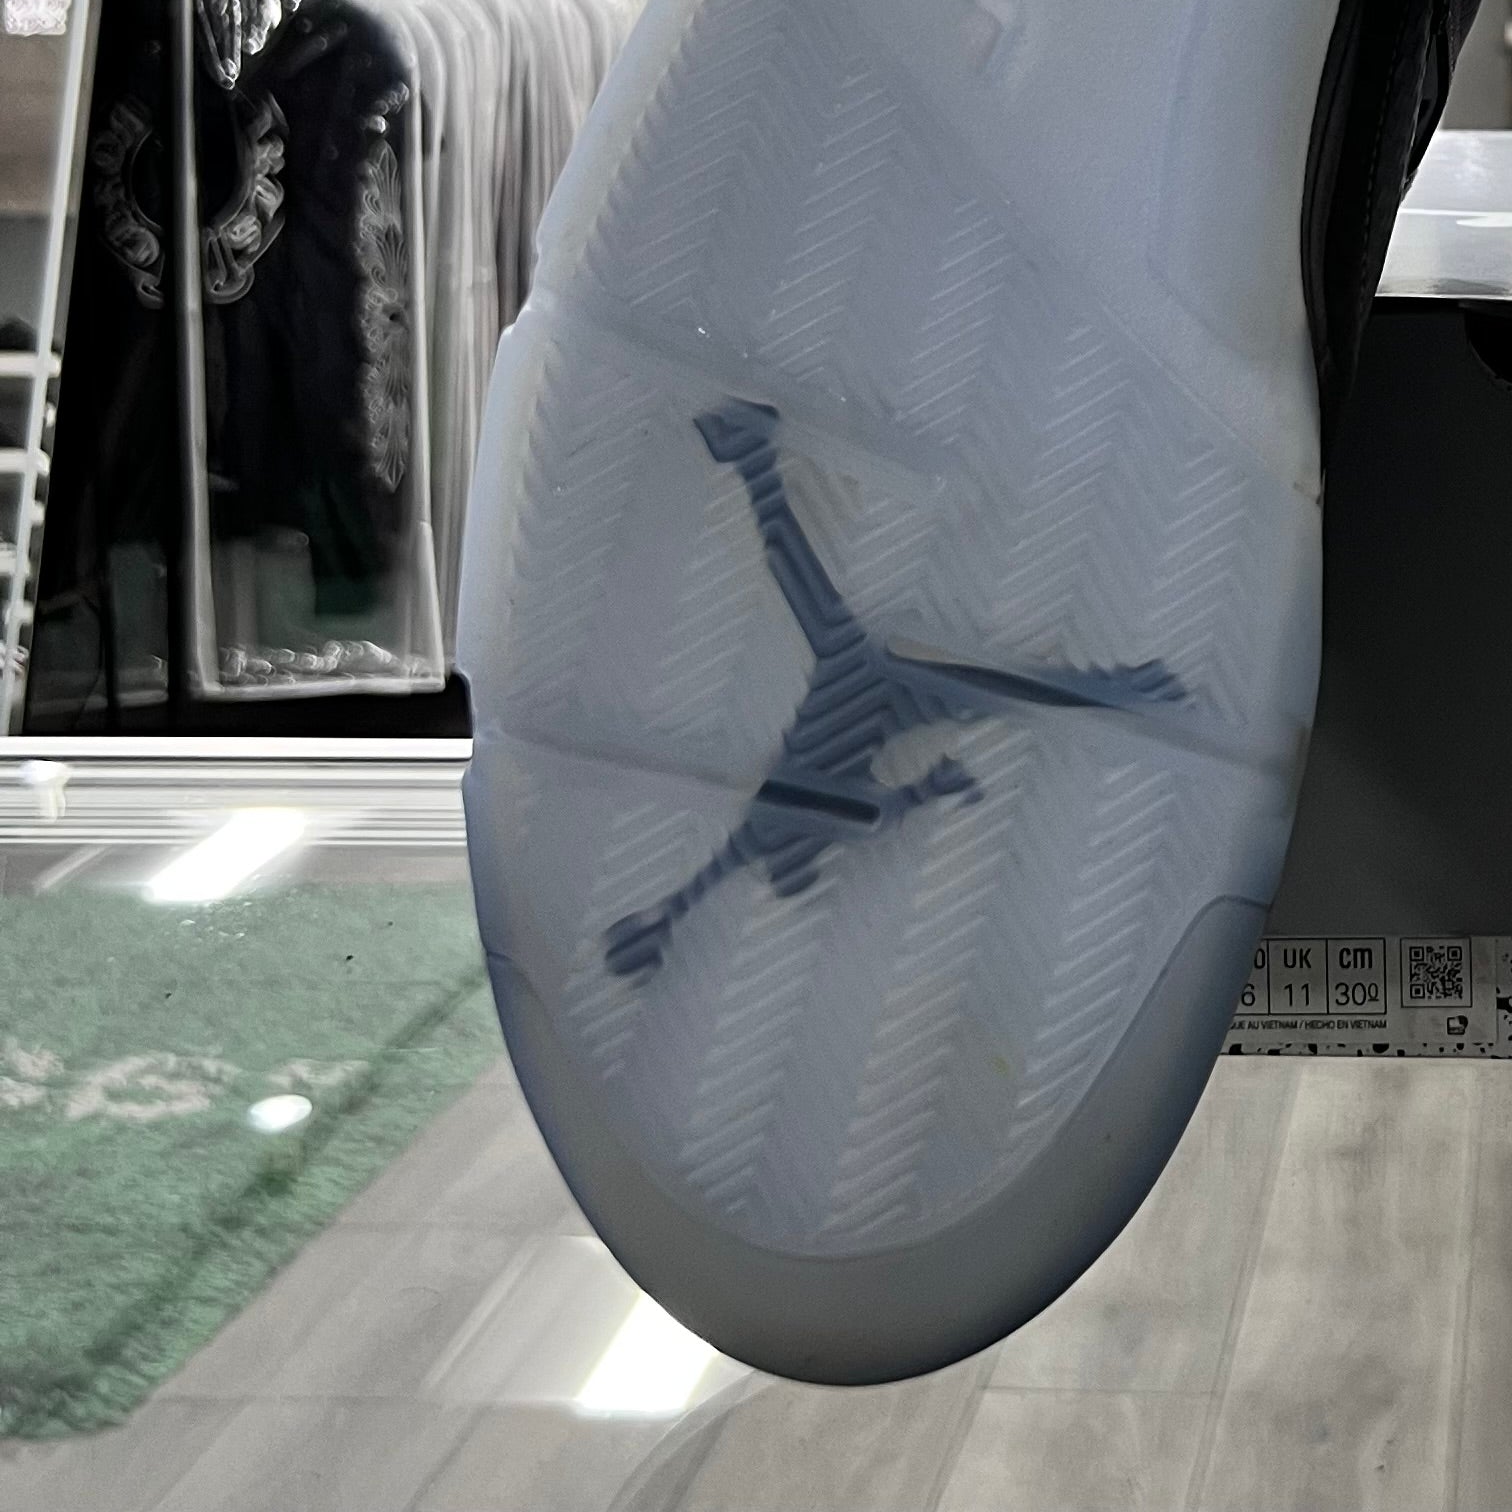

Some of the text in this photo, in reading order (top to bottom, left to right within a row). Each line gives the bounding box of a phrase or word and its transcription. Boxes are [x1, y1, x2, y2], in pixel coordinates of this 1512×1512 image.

[1283, 948, 1312, 969] UK
[1283, 983, 1310, 1006] 11
[1261, 1019, 1297, 1029] VIETNAM
[1305, 1019, 1336, 1029] HECHO
[1337, 1019, 1349, 1029] EN
[1350, 1019, 1387, 1029] VIETNAM
